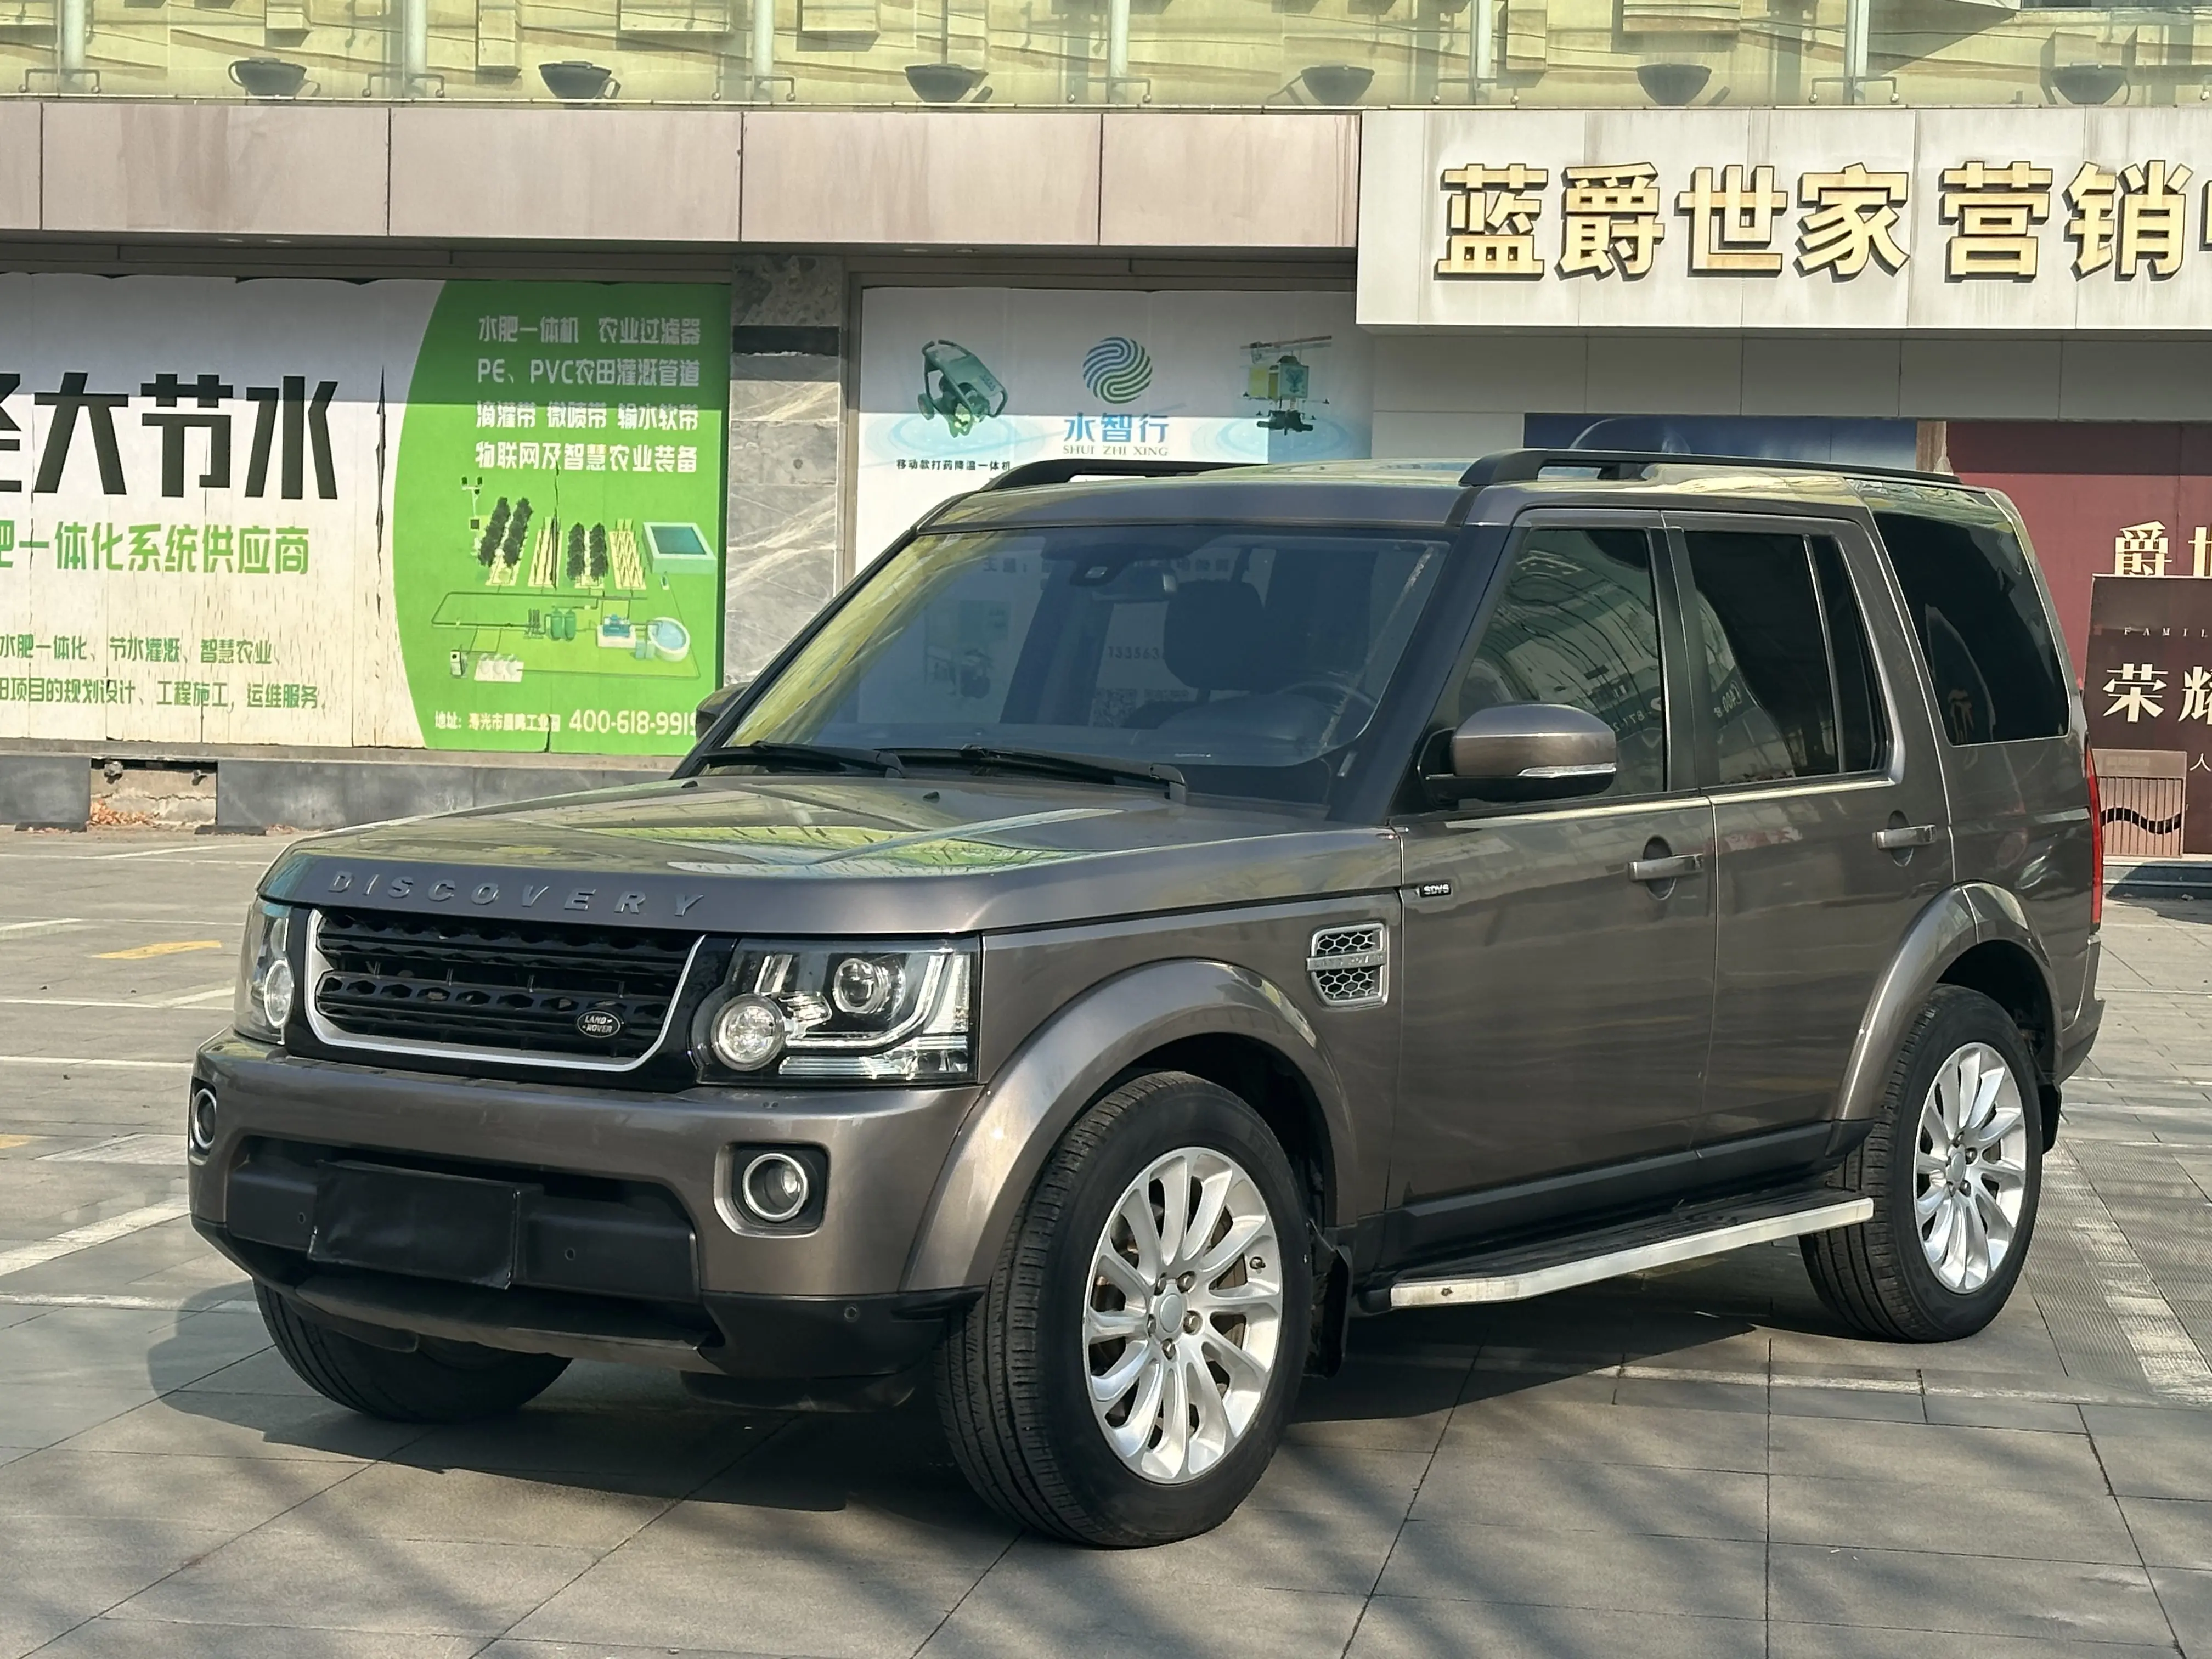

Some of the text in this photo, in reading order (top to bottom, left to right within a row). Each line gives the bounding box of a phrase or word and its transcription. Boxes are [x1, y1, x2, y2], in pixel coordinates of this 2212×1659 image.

[1435, 161, 2212, 281] 蓝爵世家营销
[479, 315, 701, 345] 水肥一体机 农业过滤器
[476, 400, 698, 431] 滴灌带 微喷带 输水软带
[1063, 412, 1169, 443] 水智行
[0, 372, 338, 500] 大节水
[1063, 445, 1169, 456] SHUI ZHI XING
[475, 441, 697, 473] 物联网及智慧农业装备
[329, 870, 704, 917] DISCOVERY
[585, 1015, 607, 1024] LAND
[586, 1024, 613, 1033] ROVER
